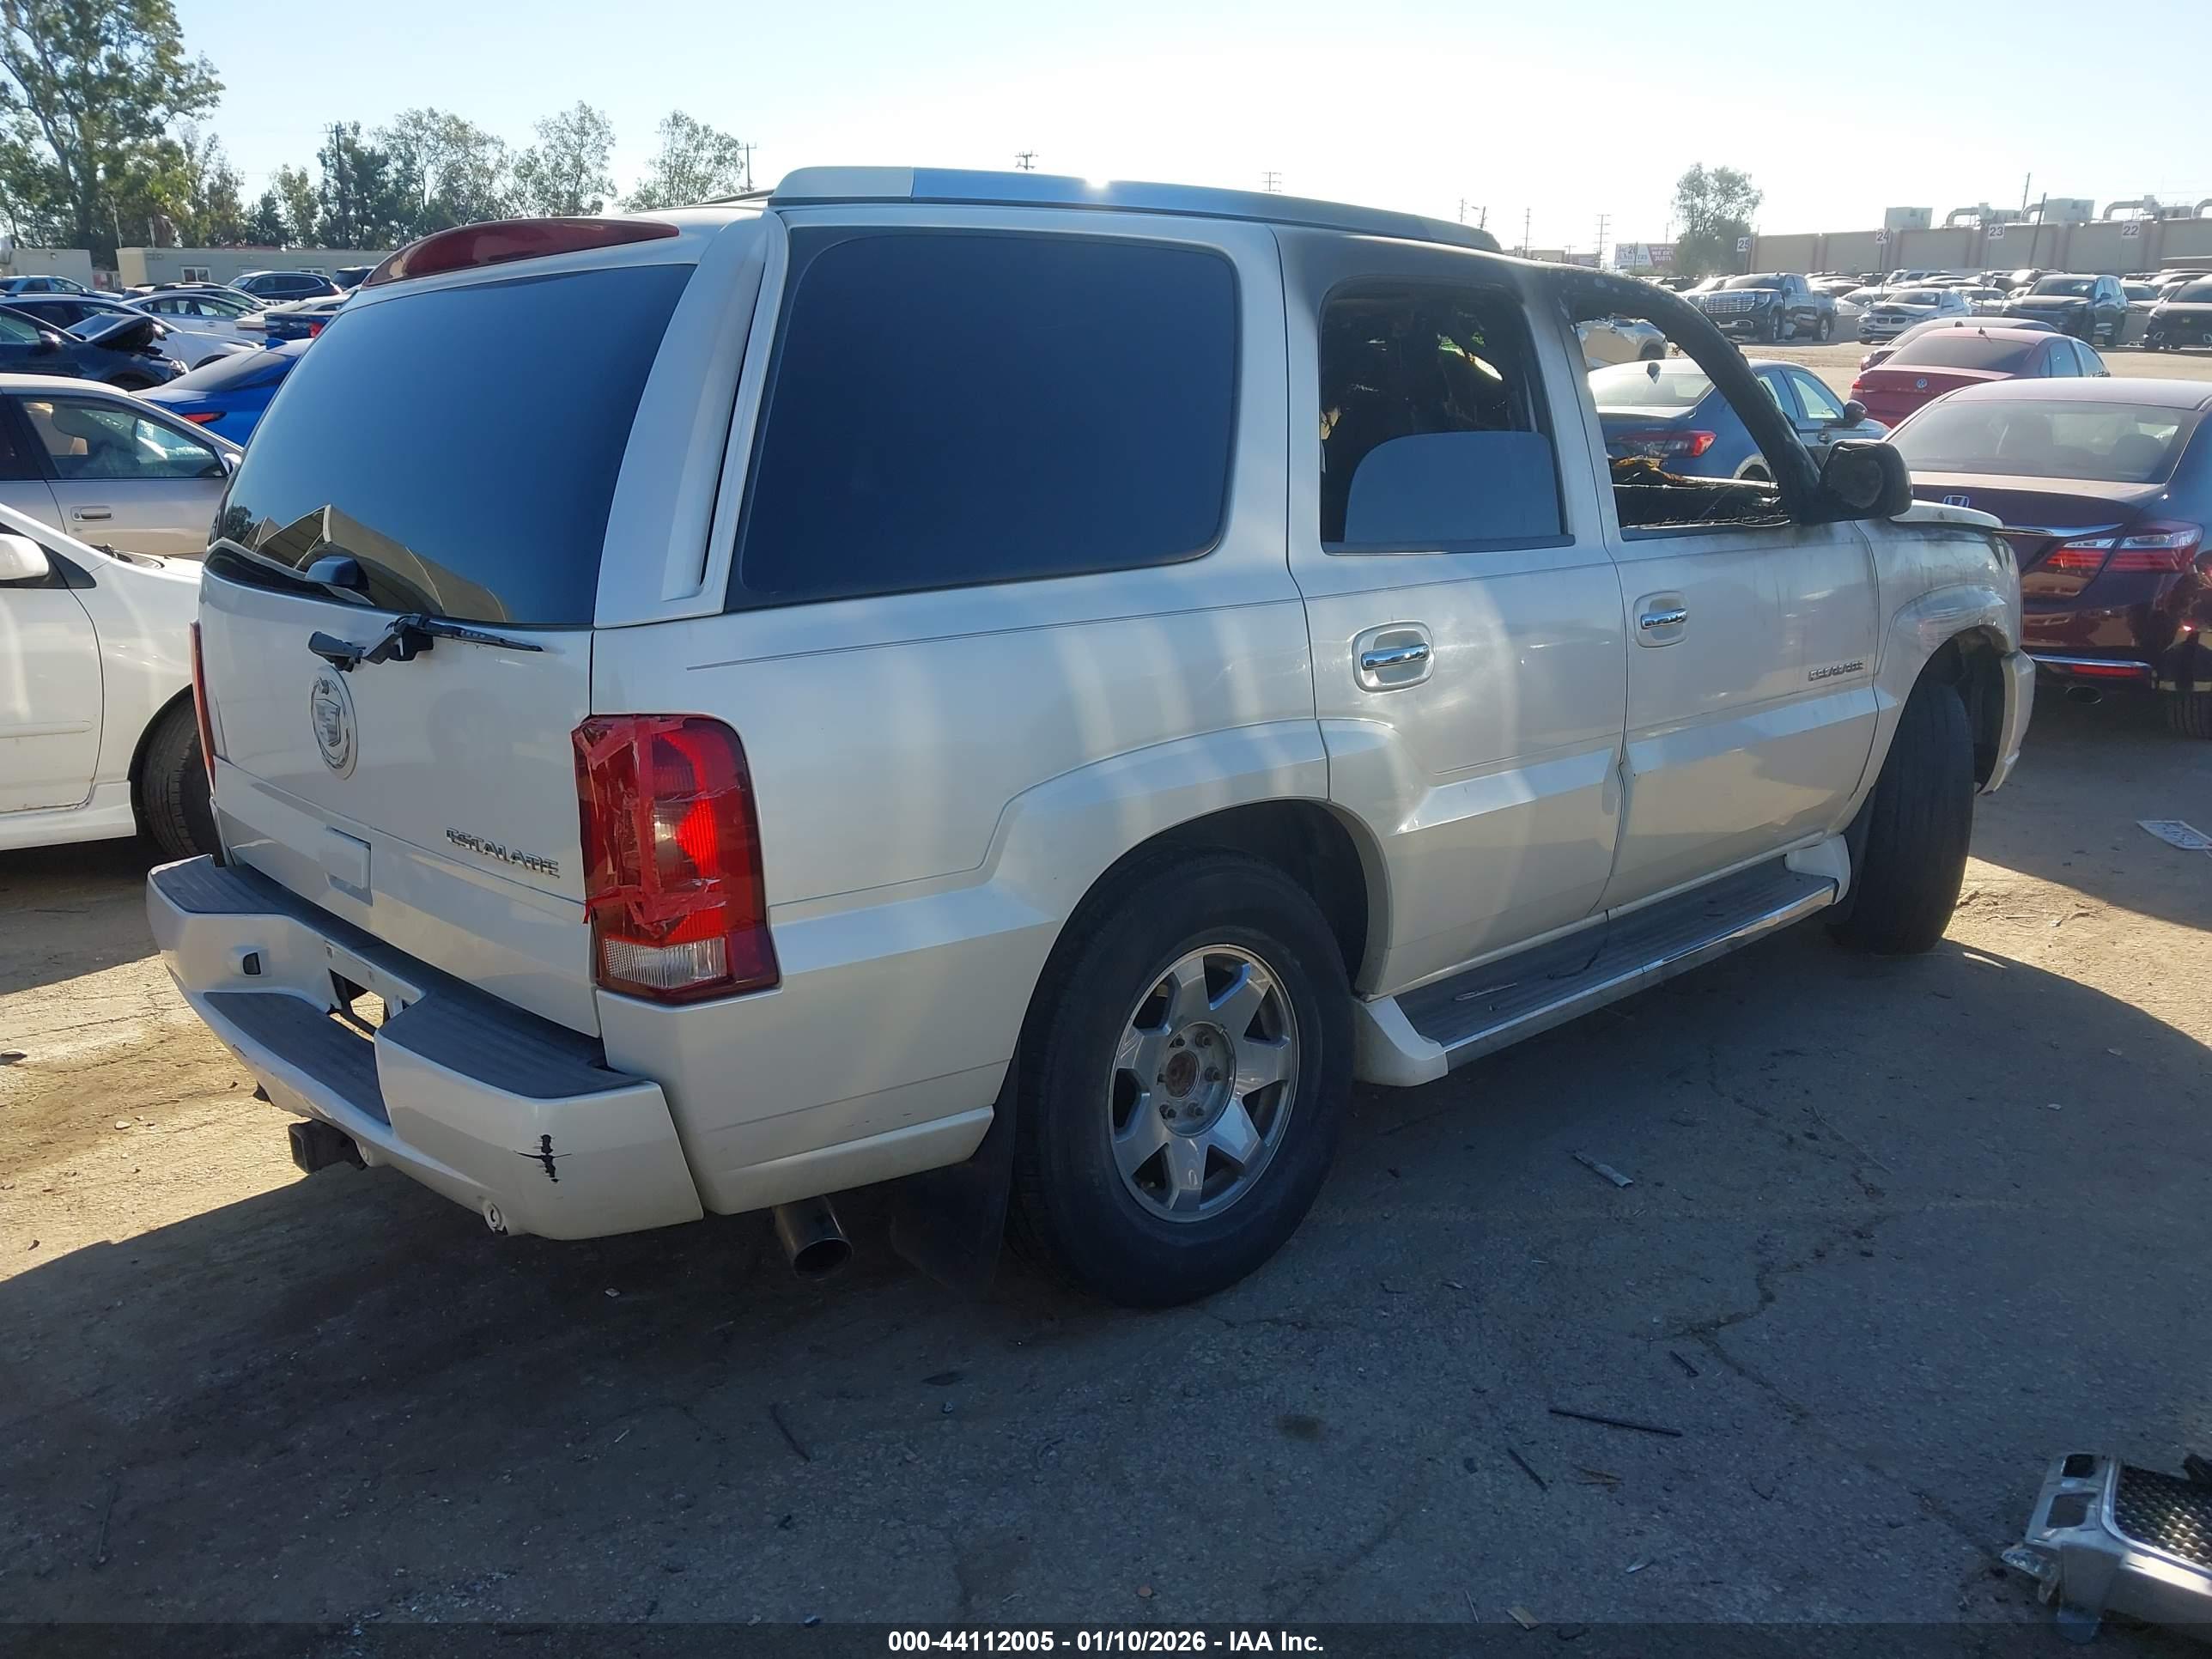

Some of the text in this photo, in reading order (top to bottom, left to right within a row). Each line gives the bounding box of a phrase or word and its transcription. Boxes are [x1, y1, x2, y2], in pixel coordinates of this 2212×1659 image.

[1990, 226, 2003, 237] 23
[2123, 225, 2138, 236] 22
[1876, 232, 1889, 241] 24
[1738, 240, 1750, 249] 25
[446, 827, 560, 878] ESCALADE
